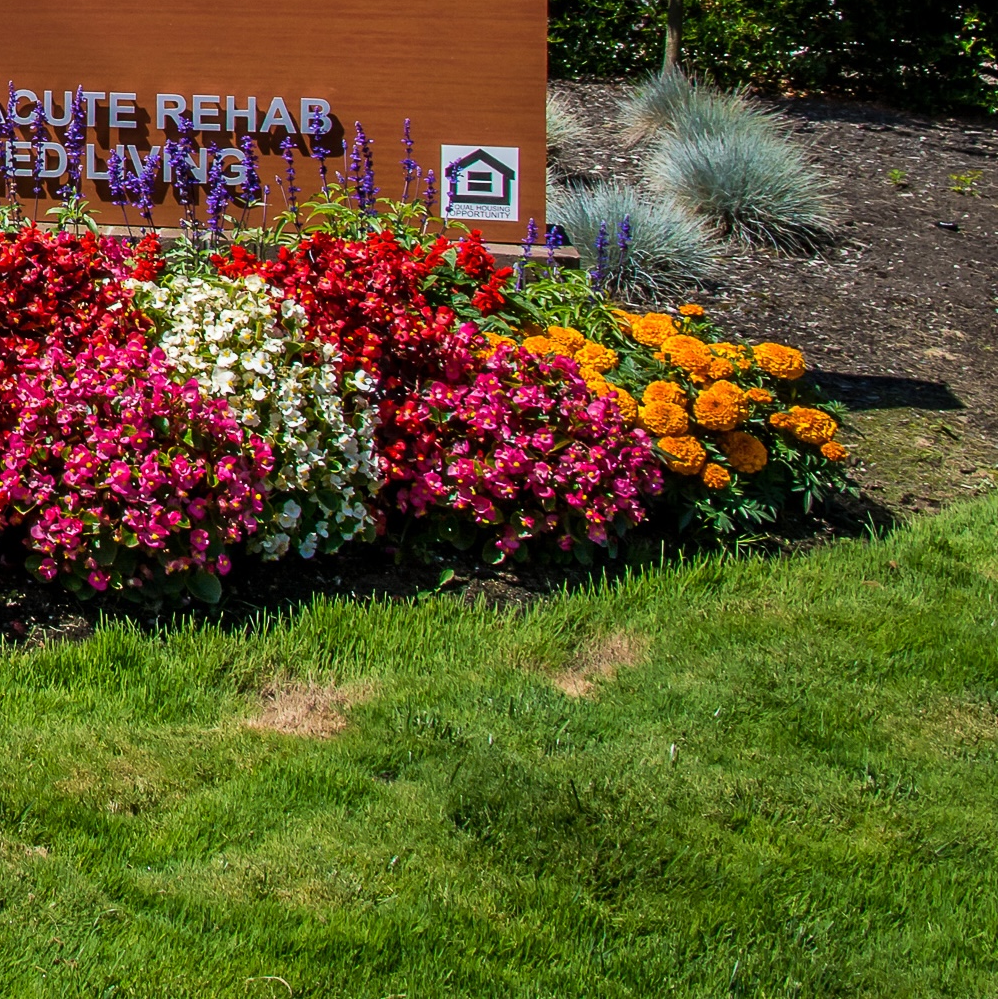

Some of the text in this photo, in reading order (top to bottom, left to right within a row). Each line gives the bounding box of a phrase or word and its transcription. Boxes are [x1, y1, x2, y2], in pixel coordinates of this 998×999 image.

[156, 93, 333, 135] REHAB
[86, 143, 249, 186] LIVING
[450, 210, 510, 218] OPPORTUNITY
[476, 204, 510, 212] HOUSING
